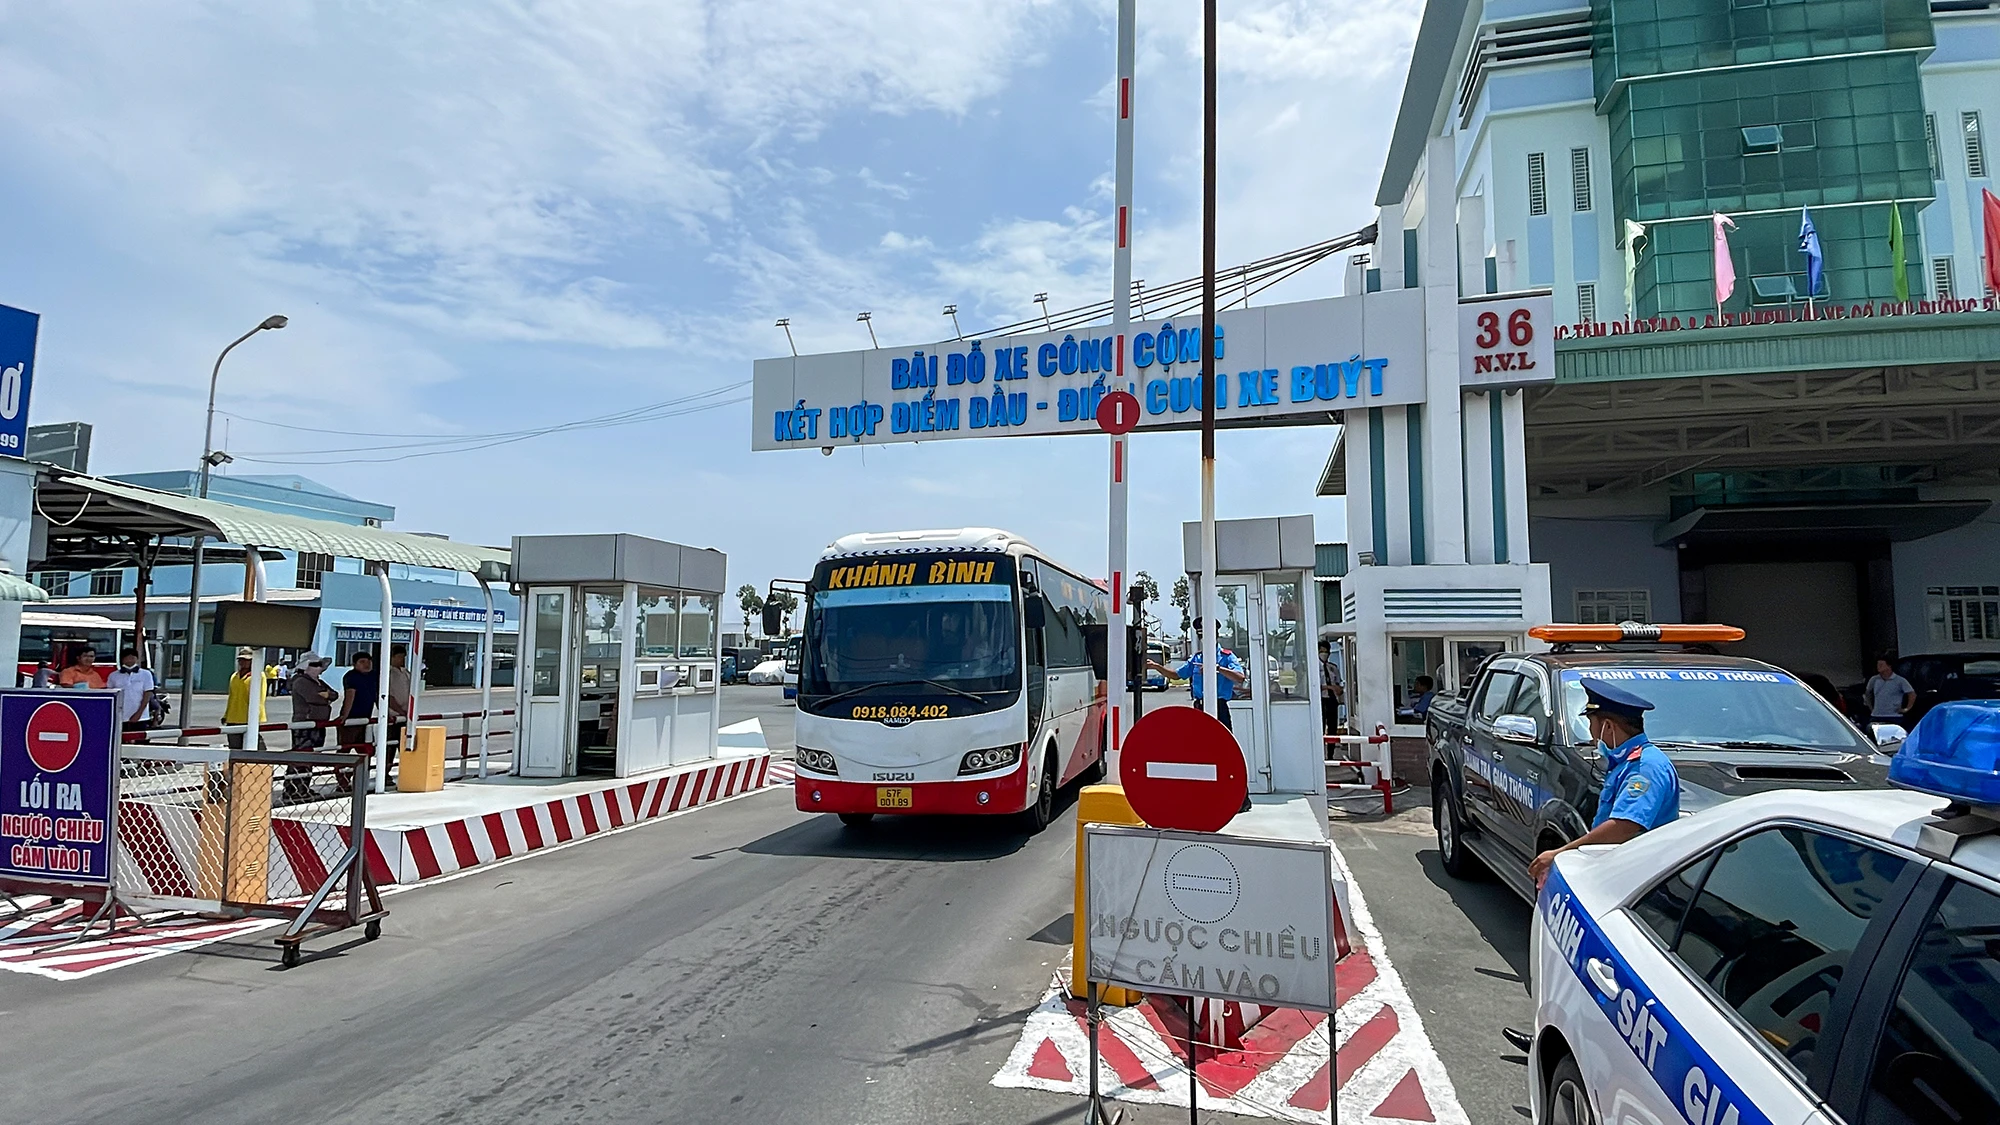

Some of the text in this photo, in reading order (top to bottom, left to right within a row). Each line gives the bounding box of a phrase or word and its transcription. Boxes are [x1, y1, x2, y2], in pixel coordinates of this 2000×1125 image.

[1476, 309, 1533, 349] 36
[891, 351, 938, 390] BÃI
[946, 340, 986, 385] ĐỖ
[994, 346, 1029, 381] XE
[1474, 351, 1536, 374] N.V.L
[0, 362, 25, 420] Ơ
[774, 400, 822, 441] KẾT
[829, 400, 884, 442] HỢP
[891, 388, 960, 434] ĐIỂM
[968, 384, 1027, 428] ĐẦU
[1057, 372, 1135, 423] ĐIỂ
[1238, 369, 1279, 408] XE
[1290, 353, 1388, 404] BUÝT
[828, 558, 995, 590] KHÁNH BÌNH
[1637, 671, 1671, 680] TRA
[1678, 671, 1719, 681] GIAO
[1719, 671, 1780, 683] THÔNG
[852, 705, 948, 718] 0918.084.402
[20, 772, 82, 811] LỐI RA
[872, 772, 915, 781] ISUZU
[1508, 777, 1534, 810] THÔNG
[2, 811, 104, 844] NGƯỢC CHIỀU
[11, 838, 45, 869] CẤM
[48, 844, 80, 872] VÀO
[1098, 914, 1320, 961] NGƯỢC CHIỀU
[1135, 953, 1280, 998] CẤM VÀO
[1547, 892, 1585, 965] CẢNH
[1617, 988, 1668, 1072] SÁT
